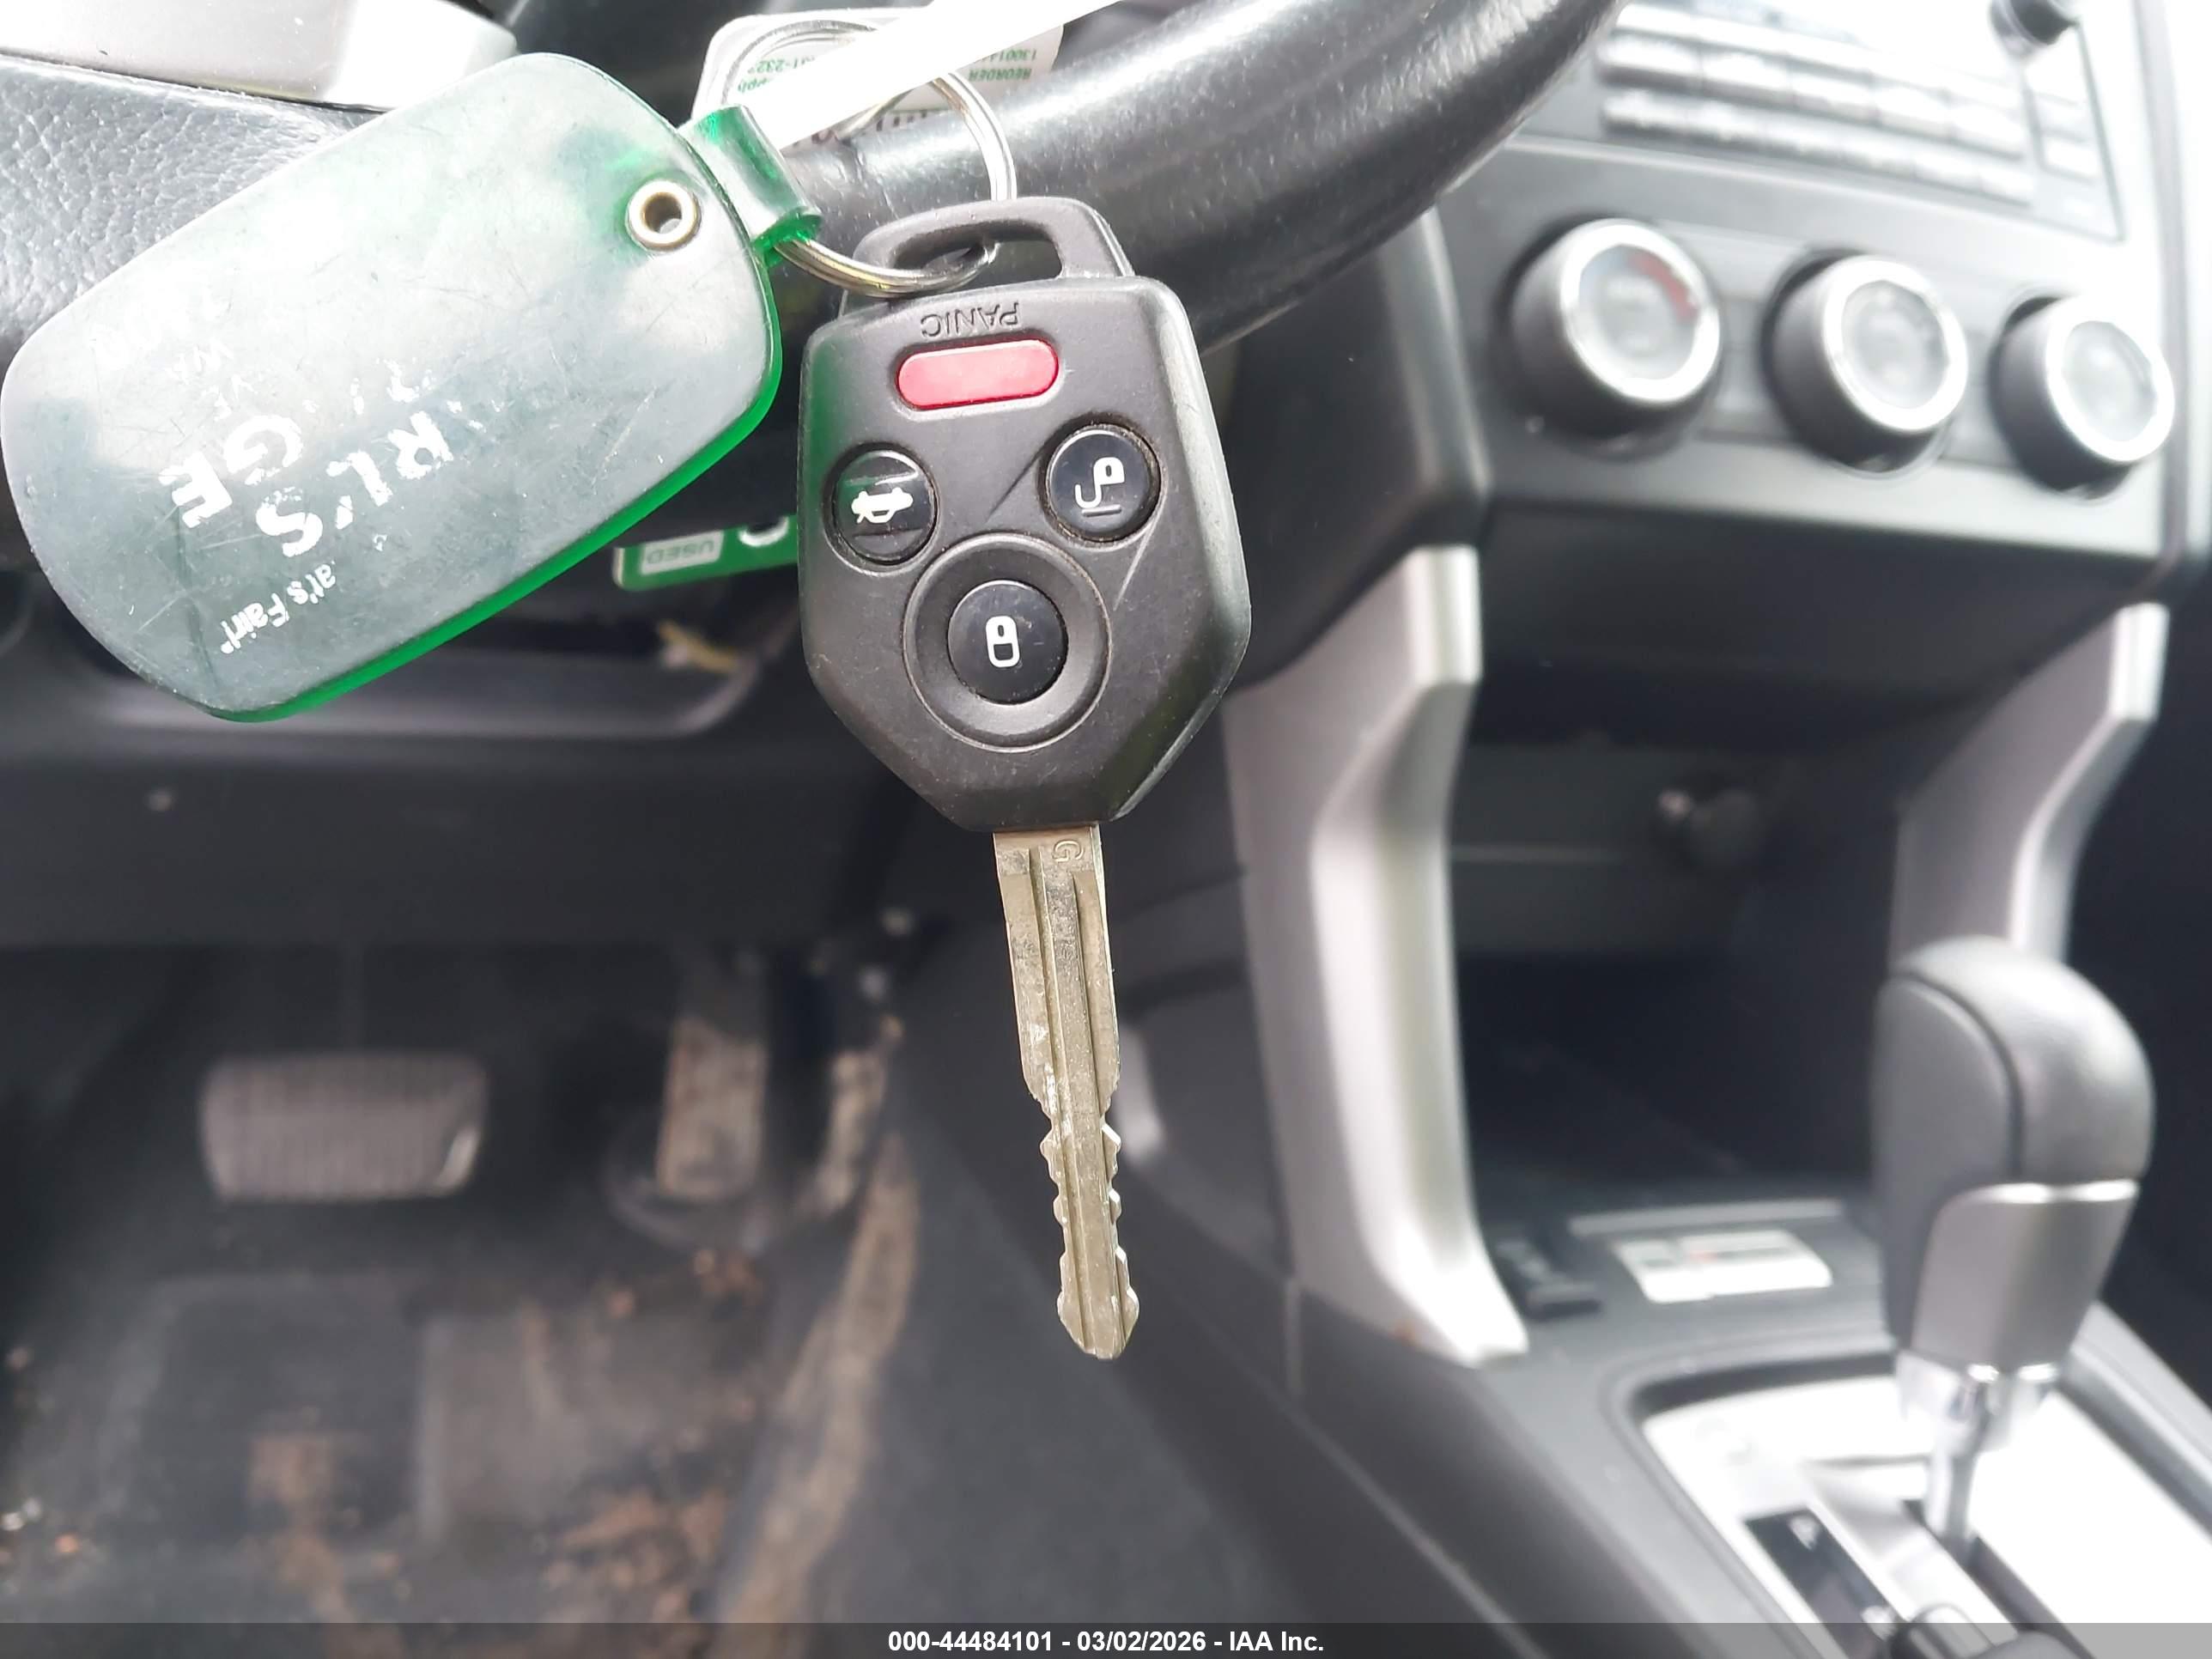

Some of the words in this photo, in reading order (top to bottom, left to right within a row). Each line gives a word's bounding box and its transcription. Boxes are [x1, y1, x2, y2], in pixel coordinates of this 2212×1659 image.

[920, 302, 1020, 338] PANIC
[255, 410, 453, 557] RL'S
[647, 540, 714, 564] USED
[287, 565, 336, 605] at's
[1052, 839, 1085, 863] G
